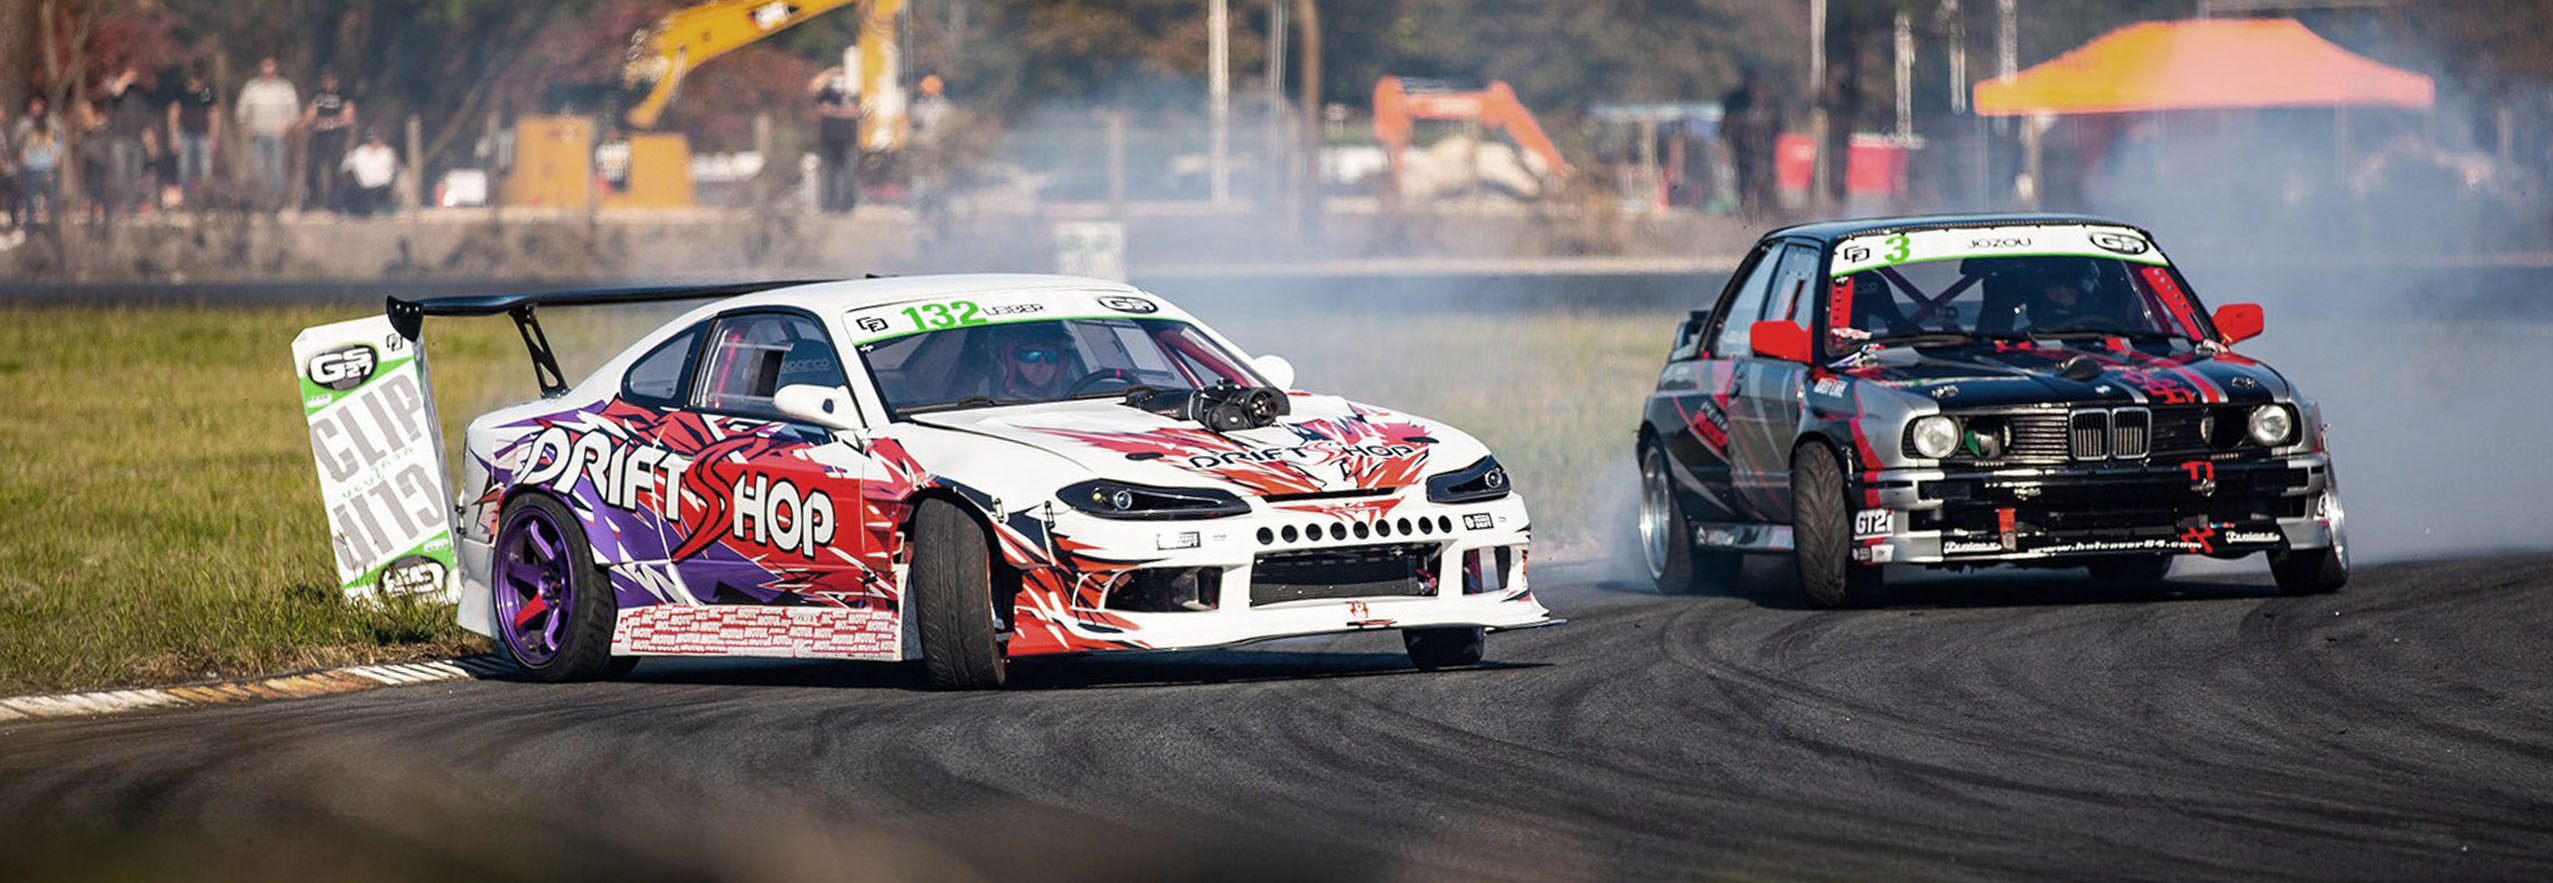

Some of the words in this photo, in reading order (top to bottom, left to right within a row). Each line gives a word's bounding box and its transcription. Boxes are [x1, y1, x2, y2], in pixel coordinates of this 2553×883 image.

[1884, 235, 1911, 263] 3
[901, 300, 988, 330] 132
[309, 374, 424, 484] CLIP
